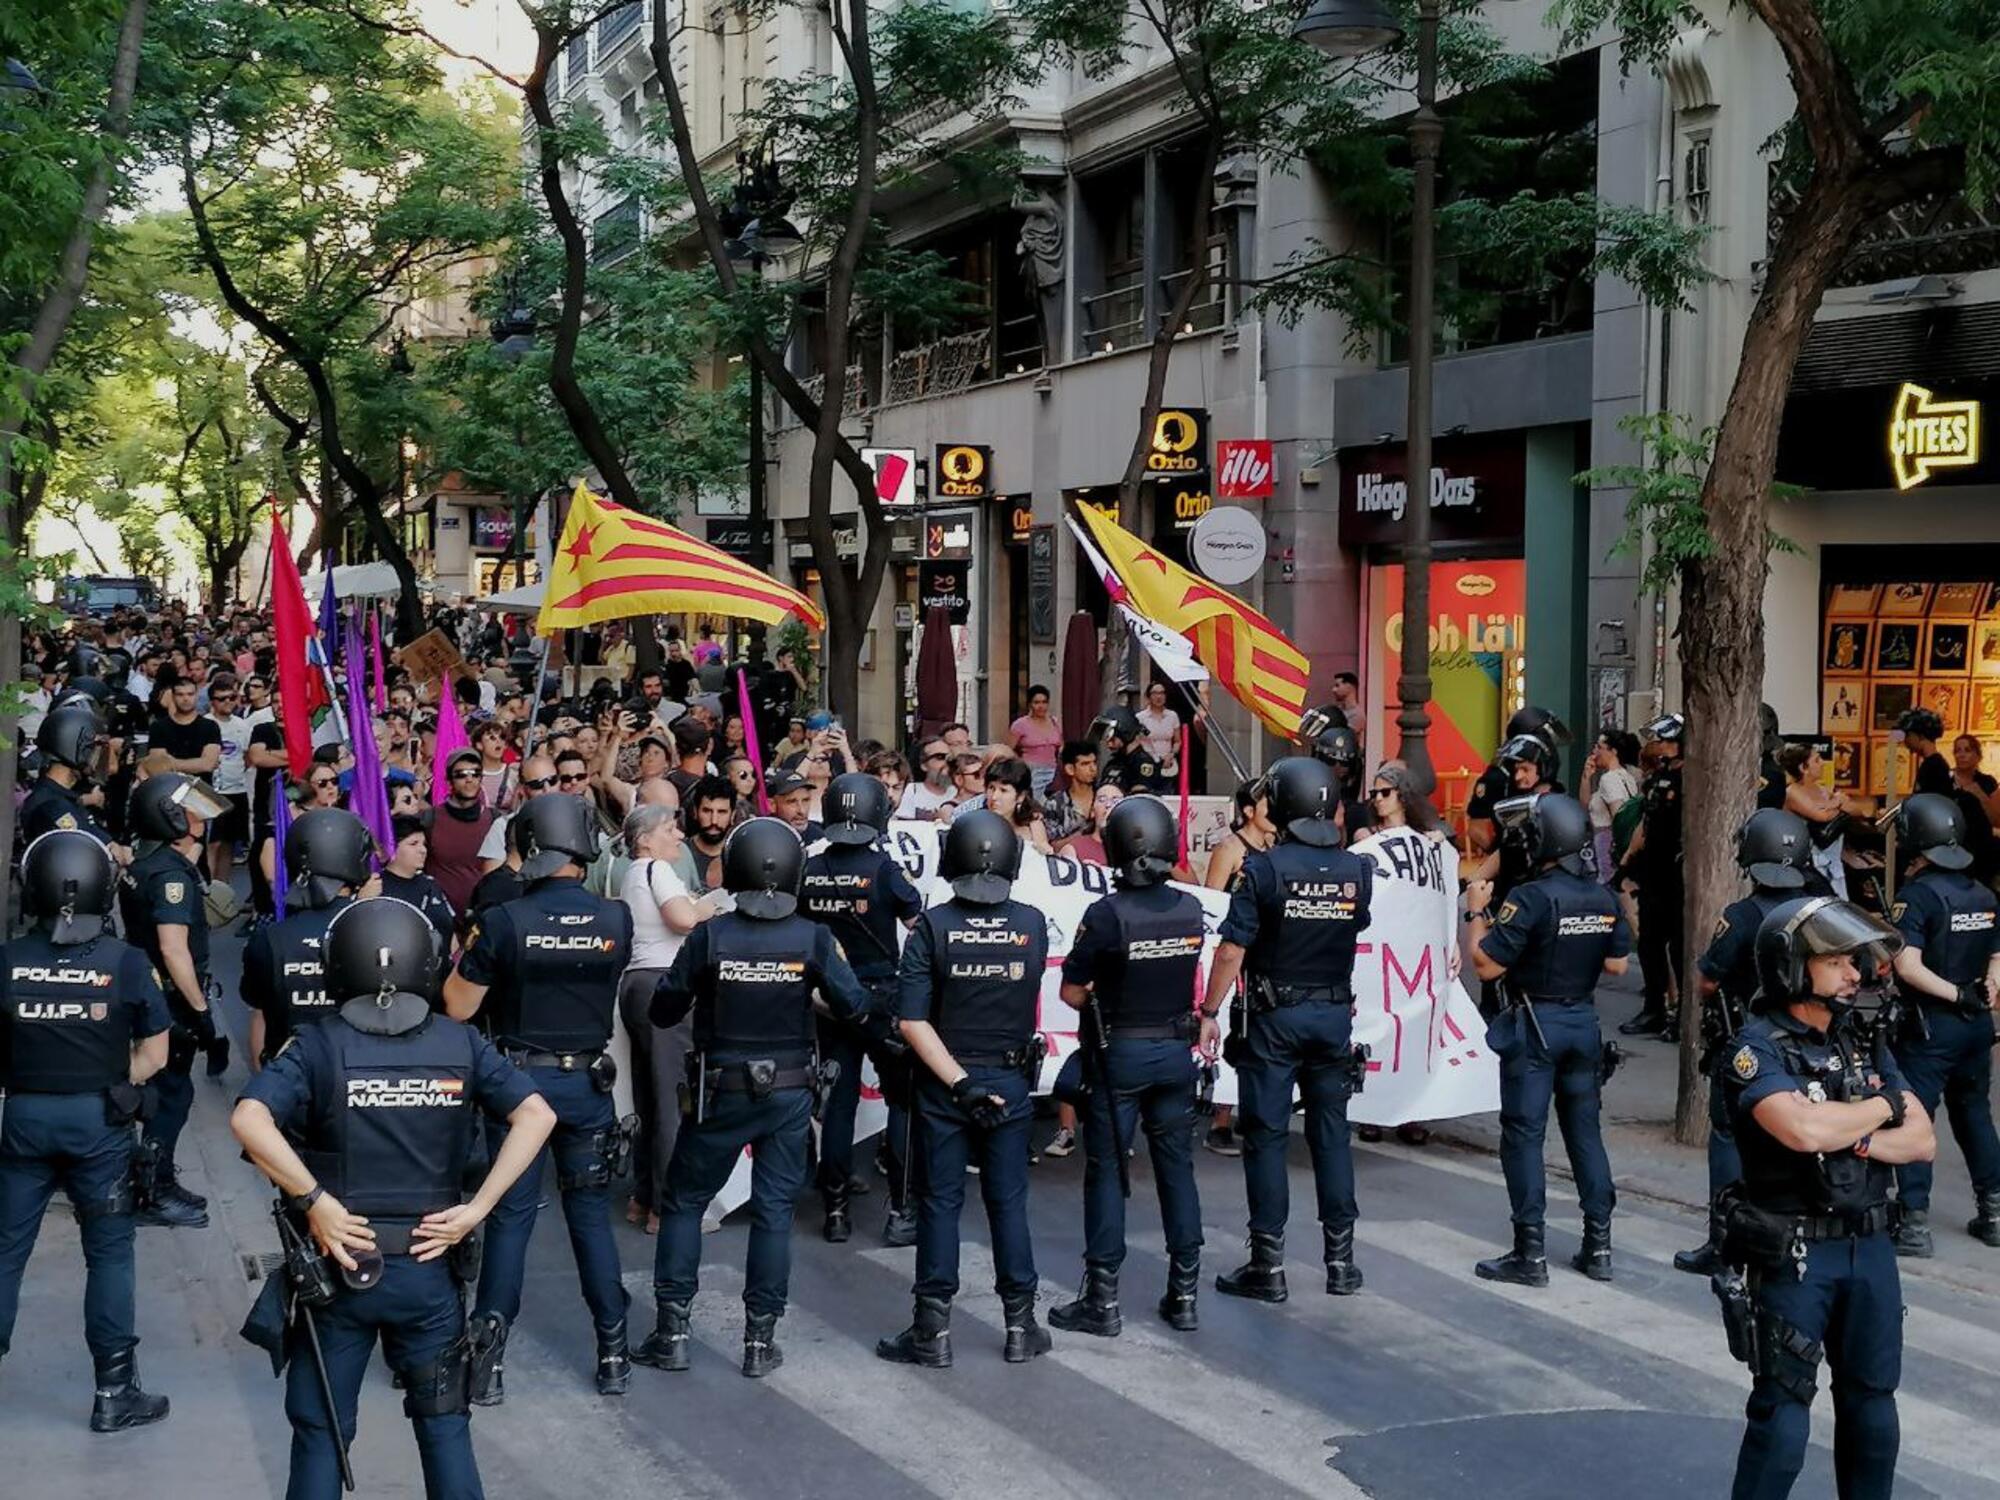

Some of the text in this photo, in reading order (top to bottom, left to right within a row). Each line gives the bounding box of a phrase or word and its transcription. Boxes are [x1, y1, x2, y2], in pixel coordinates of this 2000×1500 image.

[1890, 415, 1968, 455] CITEES
[1148, 453, 1198, 470] Orio
[1221, 447, 1269, 492] illy
[942, 481, 983, 495] Orio
[923, 595, 964, 607] vestito
[804, 874, 862, 888] POLICIA
[809, 898, 855, 913] U.I.P.
[1285, 899, 1341, 911] POLICIA
[1284, 908, 1354, 920] NACIONAL
[526, 935, 605, 950] POLICIA
[948, 930, 1019, 944] POLICIA
[719, 960, 787, 972] POLICIA
[951, 963, 1008, 978] U.I.P.
[12, 966, 101, 984] POLICIA
[719, 970, 803, 982] NACIONAL
[18, 1002, 88, 1019] U.I.P.
[347, 1079, 442, 1093] POLICIA
[347, 1092, 463, 1108] NACIONAL
